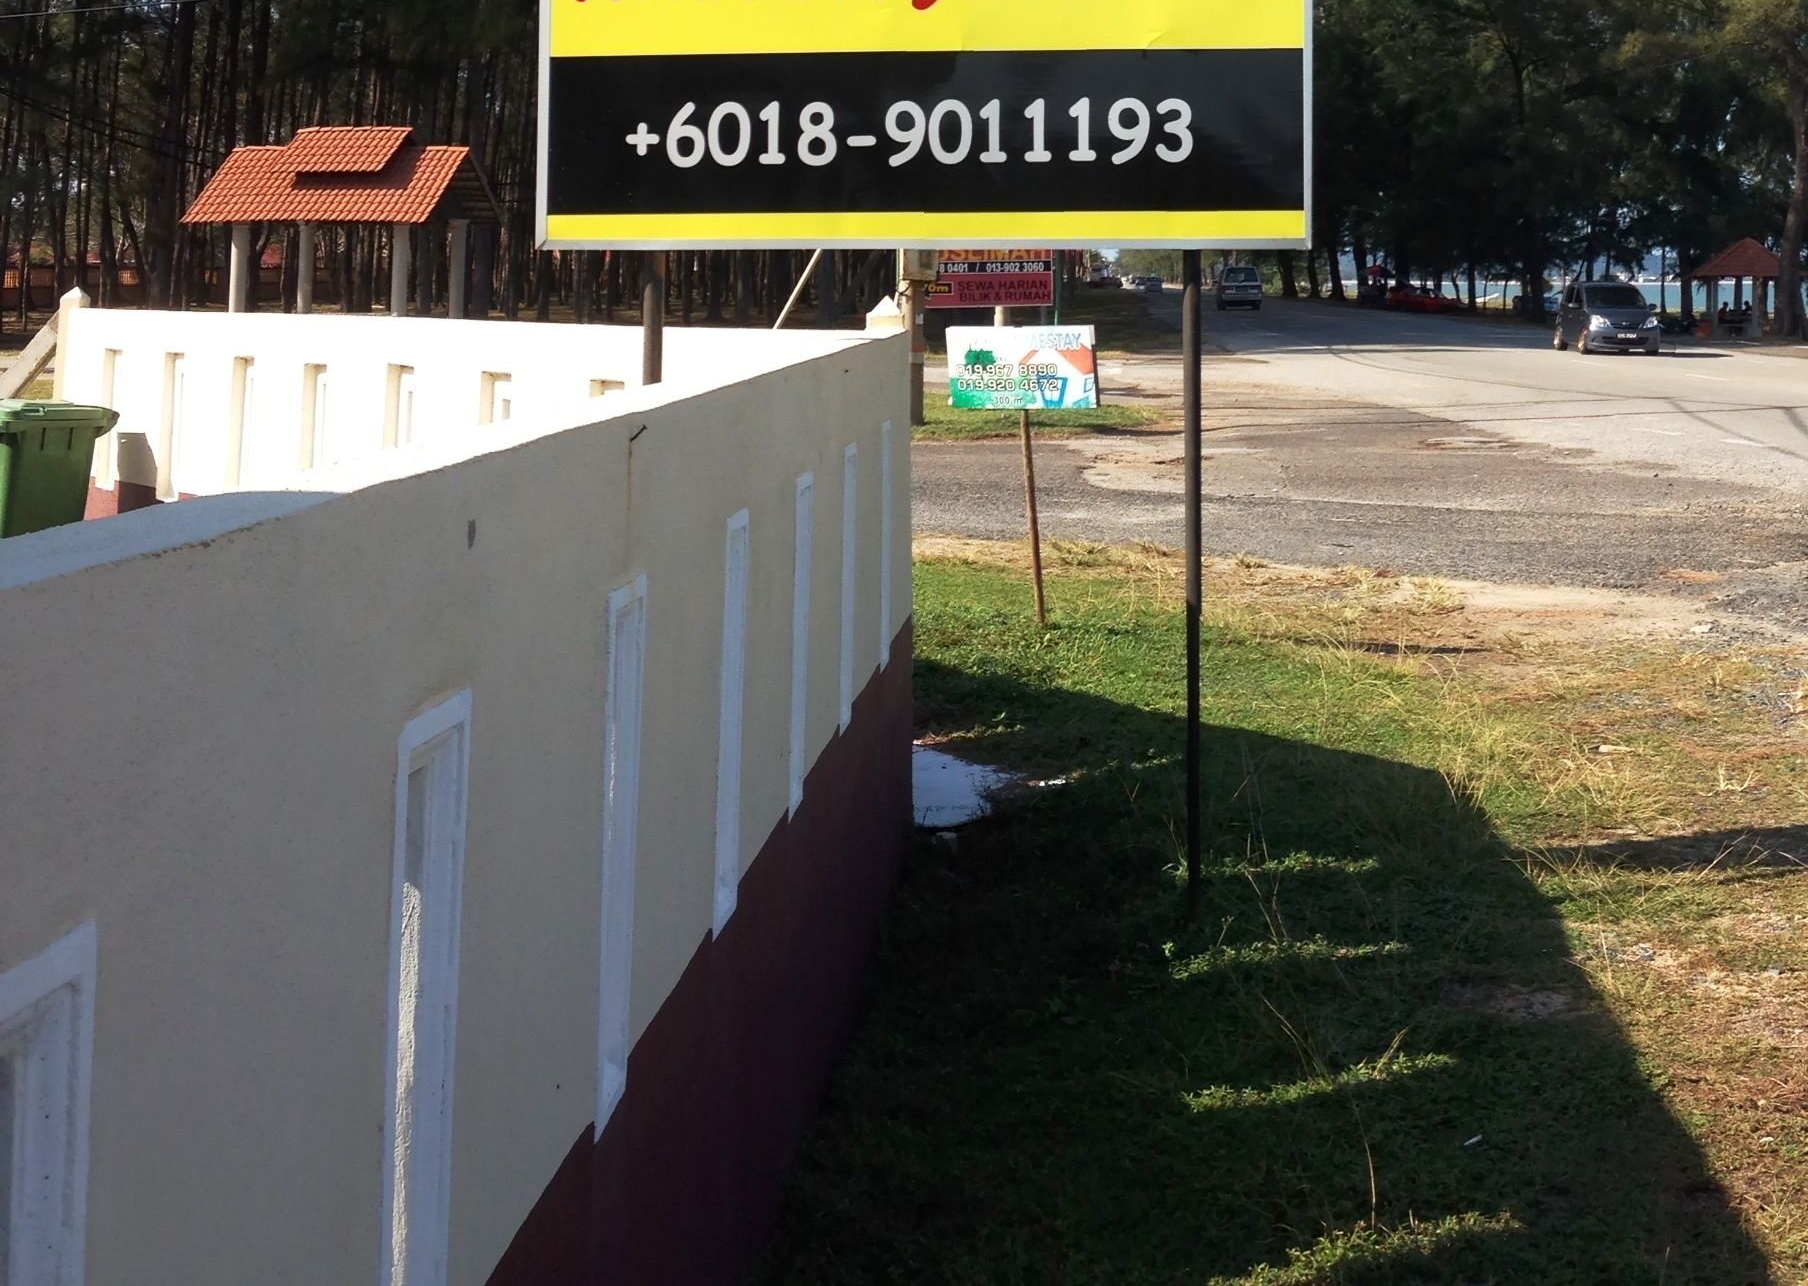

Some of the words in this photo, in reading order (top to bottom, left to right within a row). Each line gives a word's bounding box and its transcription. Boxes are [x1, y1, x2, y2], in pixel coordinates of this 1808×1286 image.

[625, 96, 1194, 169] +6018-9011193
[947, 263, 969, 273] 0401
[986, 262, 1020, 272] 013-902
[957, 280, 993, 292] SEWA
[1000, 279, 1048, 291] HARIAN
[959, 291, 991, 302] BILIK
[1004, 290, 1051, 301] RUMAH
[955, 363, 1014, 377] 019-967
[1018, 363, 1058, 377] 8890
[957, 378, 1015, 391] 019-920
[1019, 378, 1059, 391] 4672
